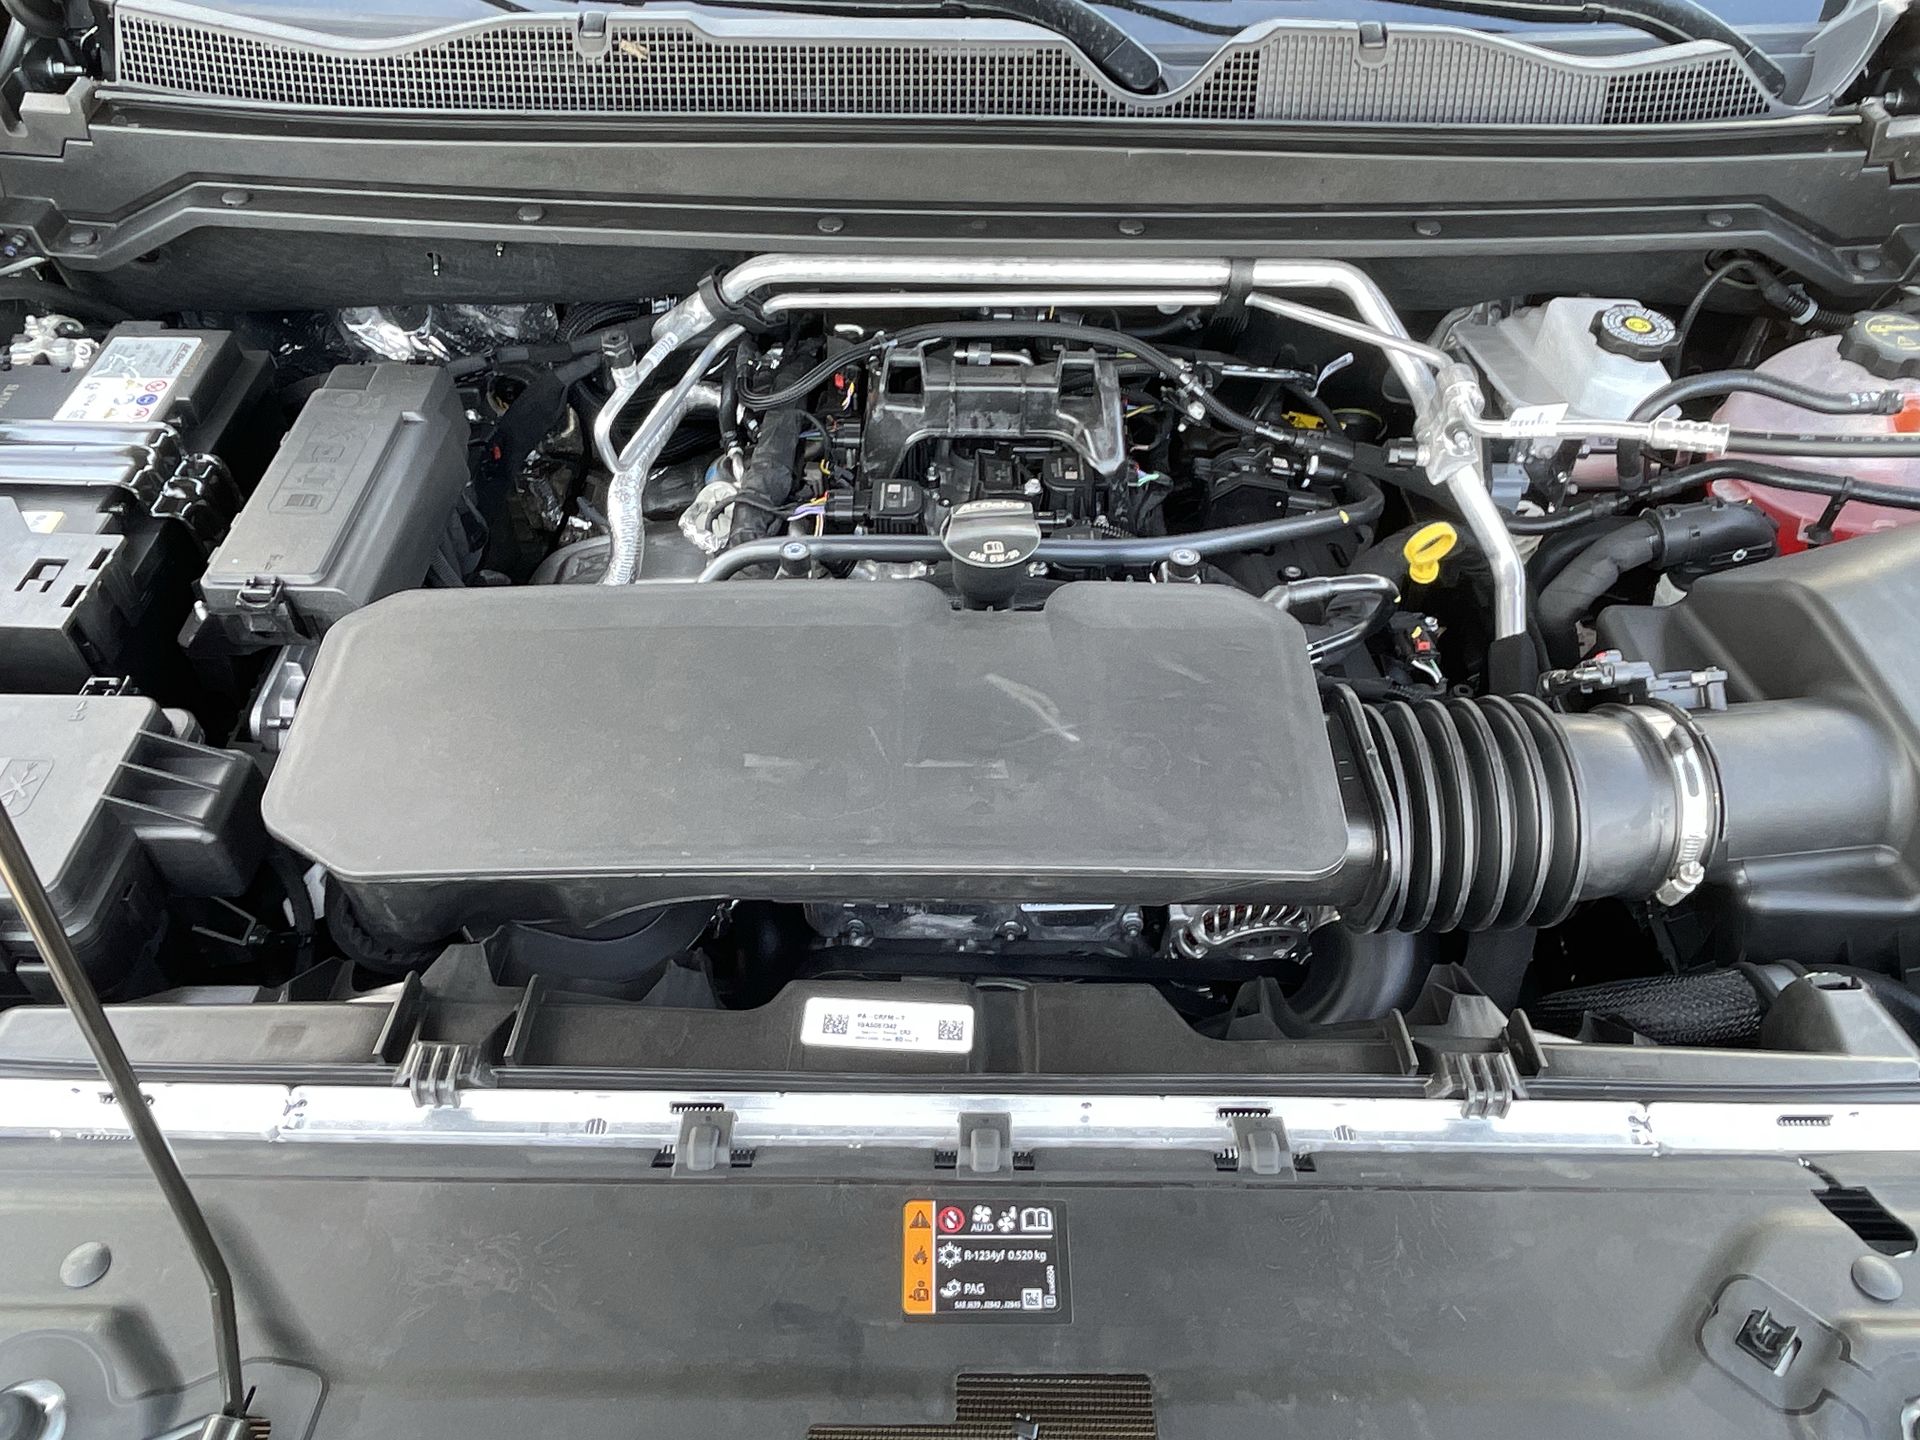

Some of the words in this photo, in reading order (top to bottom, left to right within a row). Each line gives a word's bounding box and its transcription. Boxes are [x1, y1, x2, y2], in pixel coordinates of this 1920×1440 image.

[971, 1223, 994, 1232] AUTO
[964, 1250, 1005, 1262] R-1234yf
[1008, 1250, 1034, 1261] 0.520
[1034, 1250, 1047, 1262] kg
[963, 1283, 985, 1295] PAG
